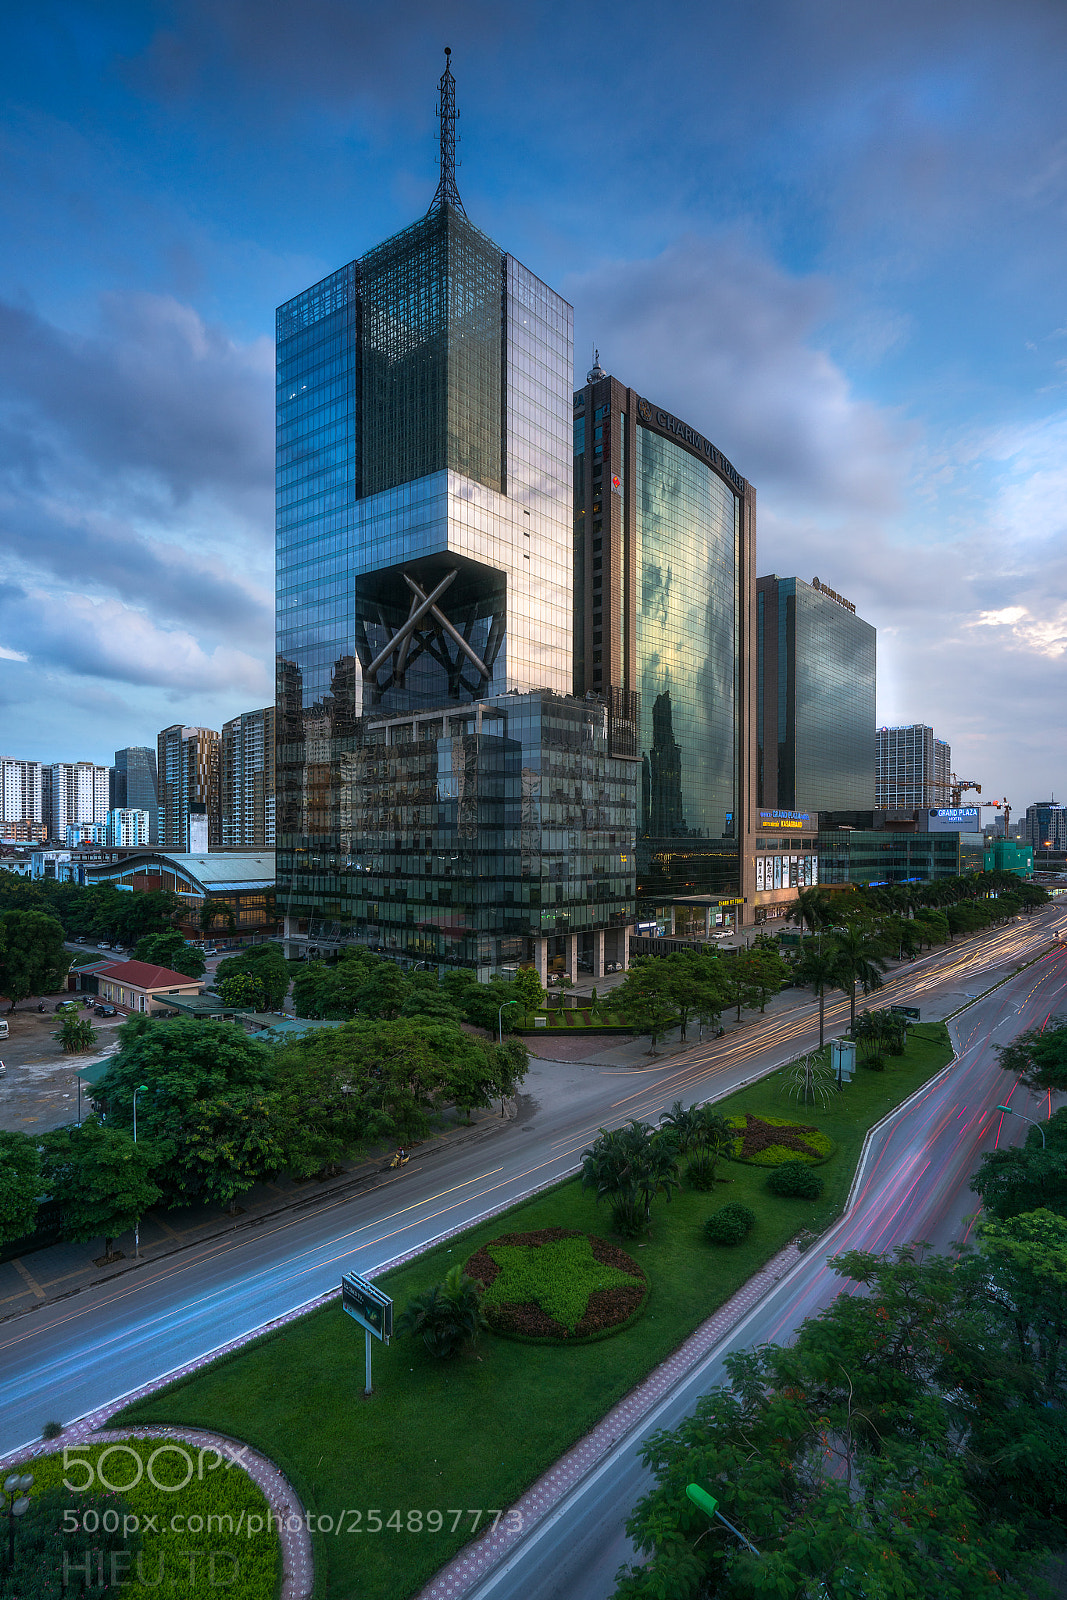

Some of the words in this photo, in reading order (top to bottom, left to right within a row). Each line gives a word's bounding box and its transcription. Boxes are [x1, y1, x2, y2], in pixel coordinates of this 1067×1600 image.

[656, 411, 703, 450] CHARM
[703, 439, 719, 464] VIT
[719, 454, 745, 492] TOWER
[772, 810, 788, 819] GRAND
[937, 809, 958, 817] GRAND
[958, 808, 978, 816] PLAZA
